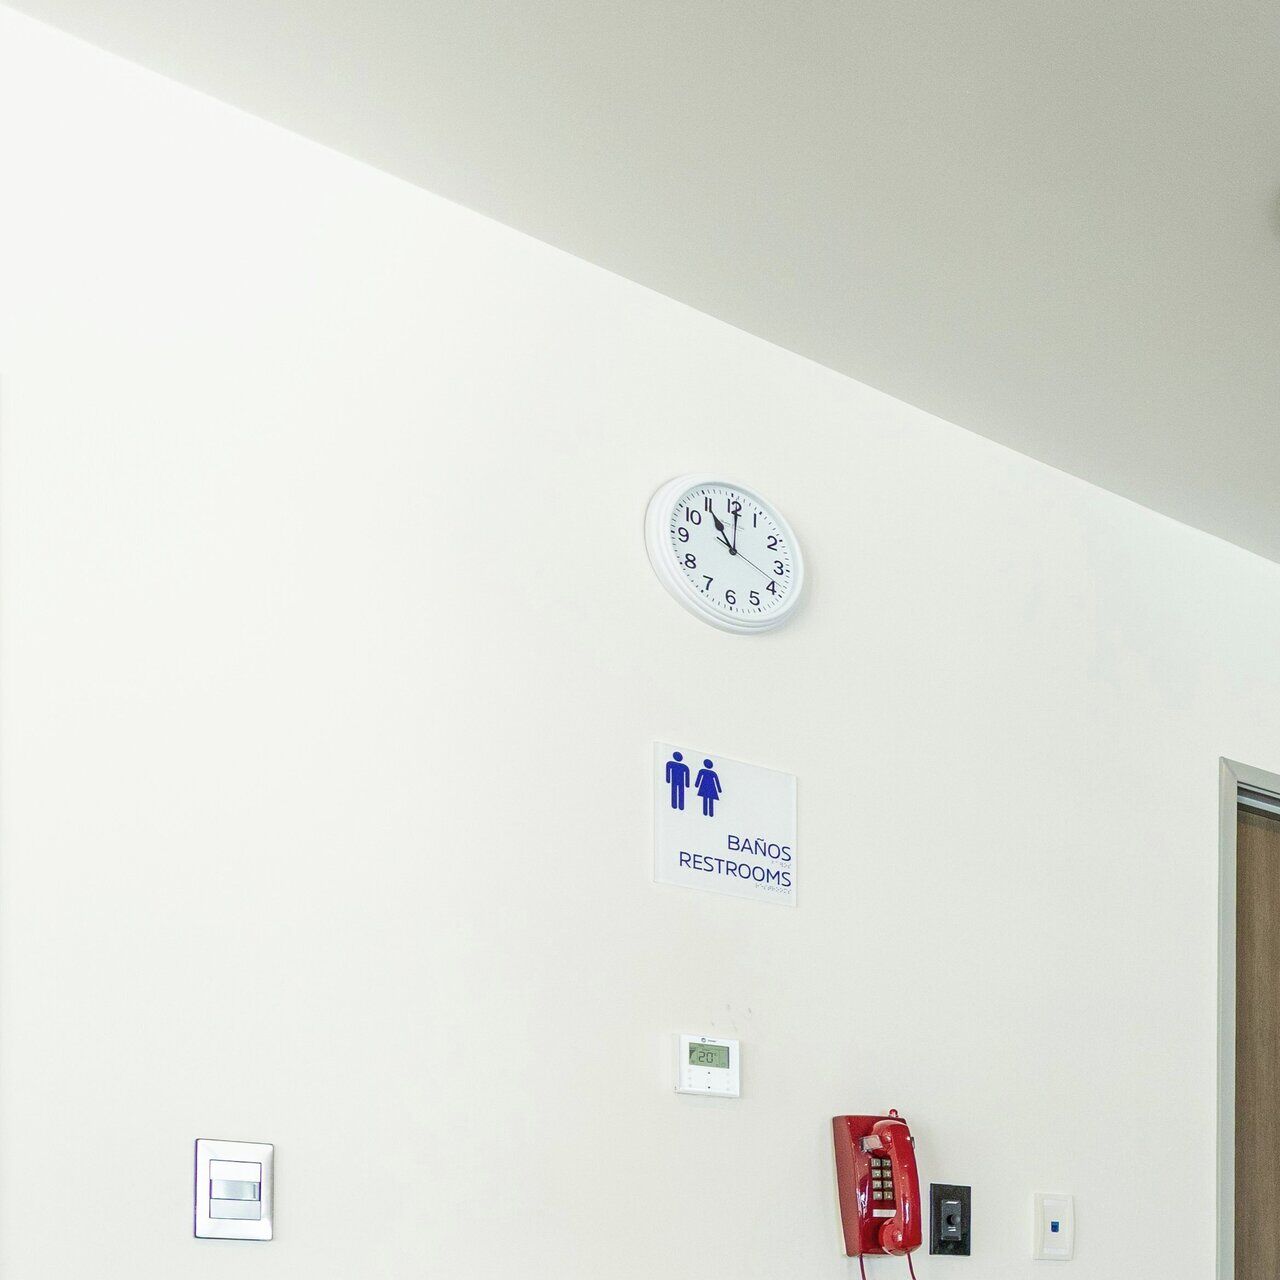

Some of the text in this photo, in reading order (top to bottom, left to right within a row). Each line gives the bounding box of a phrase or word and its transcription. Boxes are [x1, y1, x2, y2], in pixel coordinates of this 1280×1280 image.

[704, 496, 713, 513] 11
[727, 498, 742, 517] 12
[686, 506, 702, 525] 10
[678, 526, 690, 543] 9
[766, 535, 778, 551] 2
[684, 553, 697, 569] 8
[773, 560, 784, 575] 3
[702, 574, 714, 590] 7
[765, 580, 777, 596] 4
[725, 589, 736, 605] 6
[749, 590, 760, 606] 5
[727, 835, 792, 863] BAÑOS
[679, 851, 792, 887] RESTROOMS
